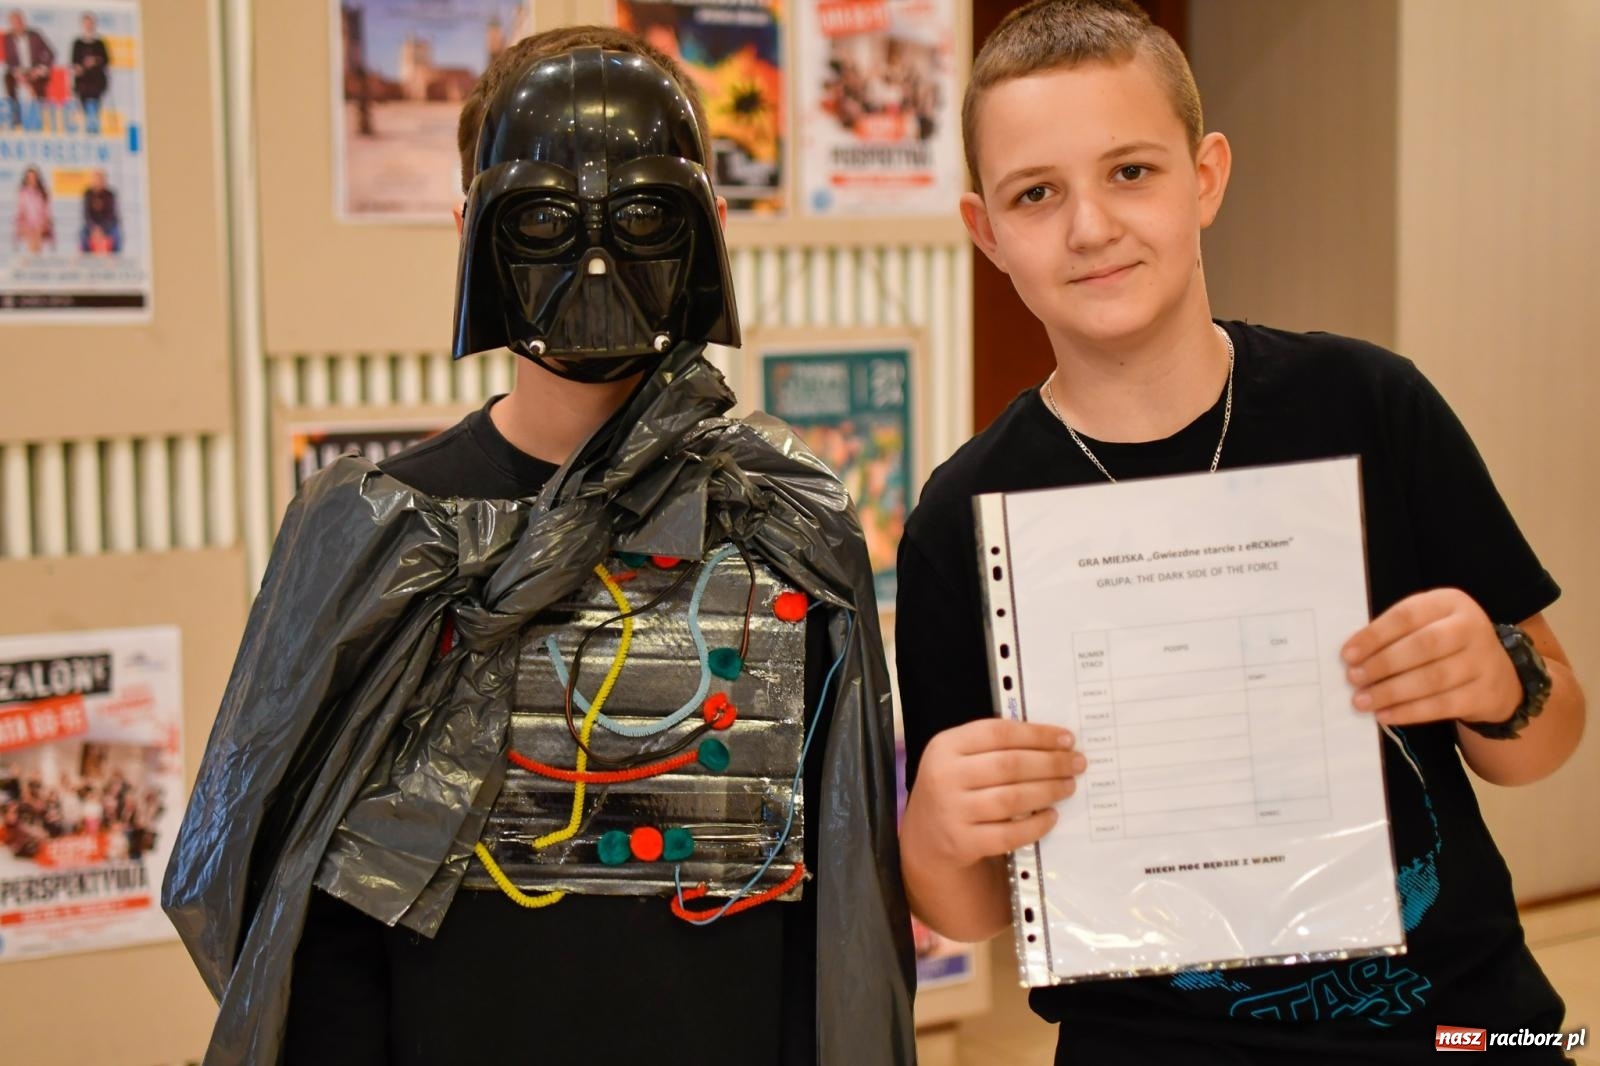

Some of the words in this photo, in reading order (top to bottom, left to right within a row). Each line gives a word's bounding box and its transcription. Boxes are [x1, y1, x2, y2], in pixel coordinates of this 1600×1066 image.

[1079, 557, 1100, 568] GRA
[1102, 553, 1144, 565] MIEJSKA
[1203, 544, 1235, 555] starcie
[1097, 576, 1134, 588] GRUPA:
[1136, 573, 1154, 584] THE
[1158, 571, 1184, 582] DARK
[1186, 568, 1207, 579] SIDE
[1210, 566, 1222, 576] OF
[1227, 565, 1244, 575] THE
[1247, 561, 1279, 572] FORCE
[1078, 650, 1104, 659] NUMER
[1144, 865, 1176, 875] NIECH
[1178, 863, 1201, 872] MOC
[1203, 859, 1240, 871] BĘDZIE
